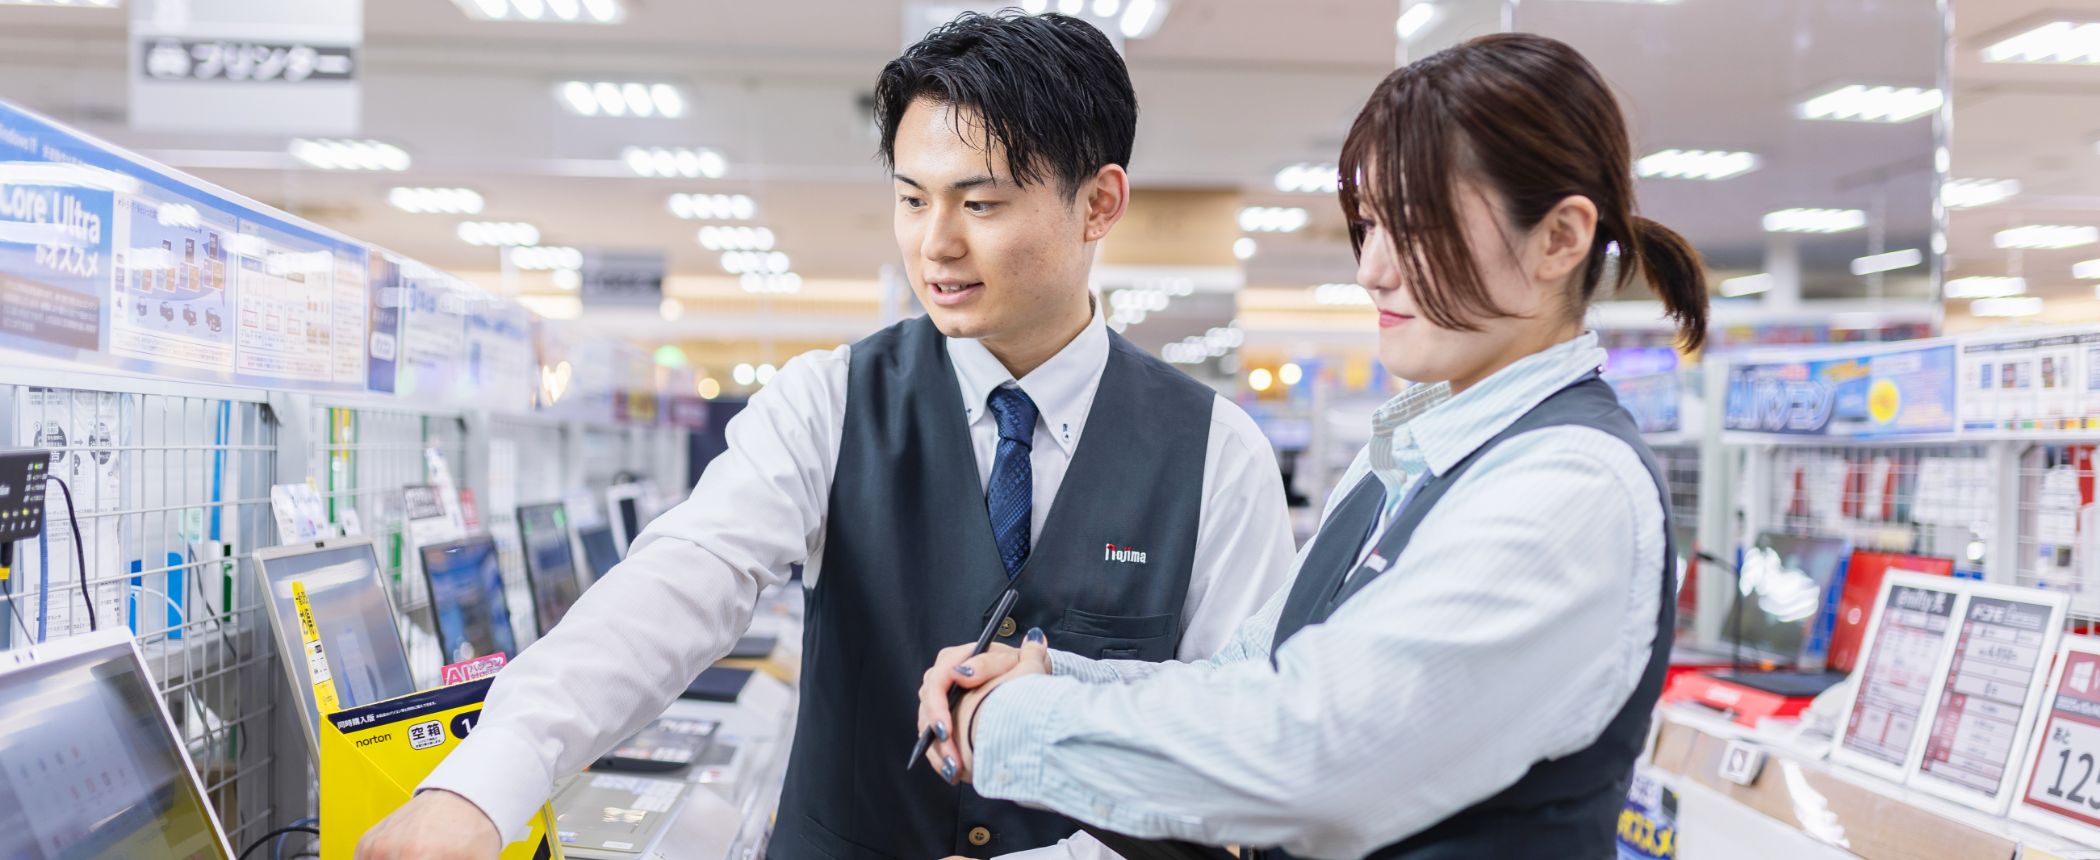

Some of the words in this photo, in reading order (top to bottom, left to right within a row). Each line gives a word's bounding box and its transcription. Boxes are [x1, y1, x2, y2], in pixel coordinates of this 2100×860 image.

[191, 42, 351, 81] プリンター
[53, 191, 101, 245] Ultra
[356, 733, 392, 748] norton
[411, 723, 442, 741] 空箱
